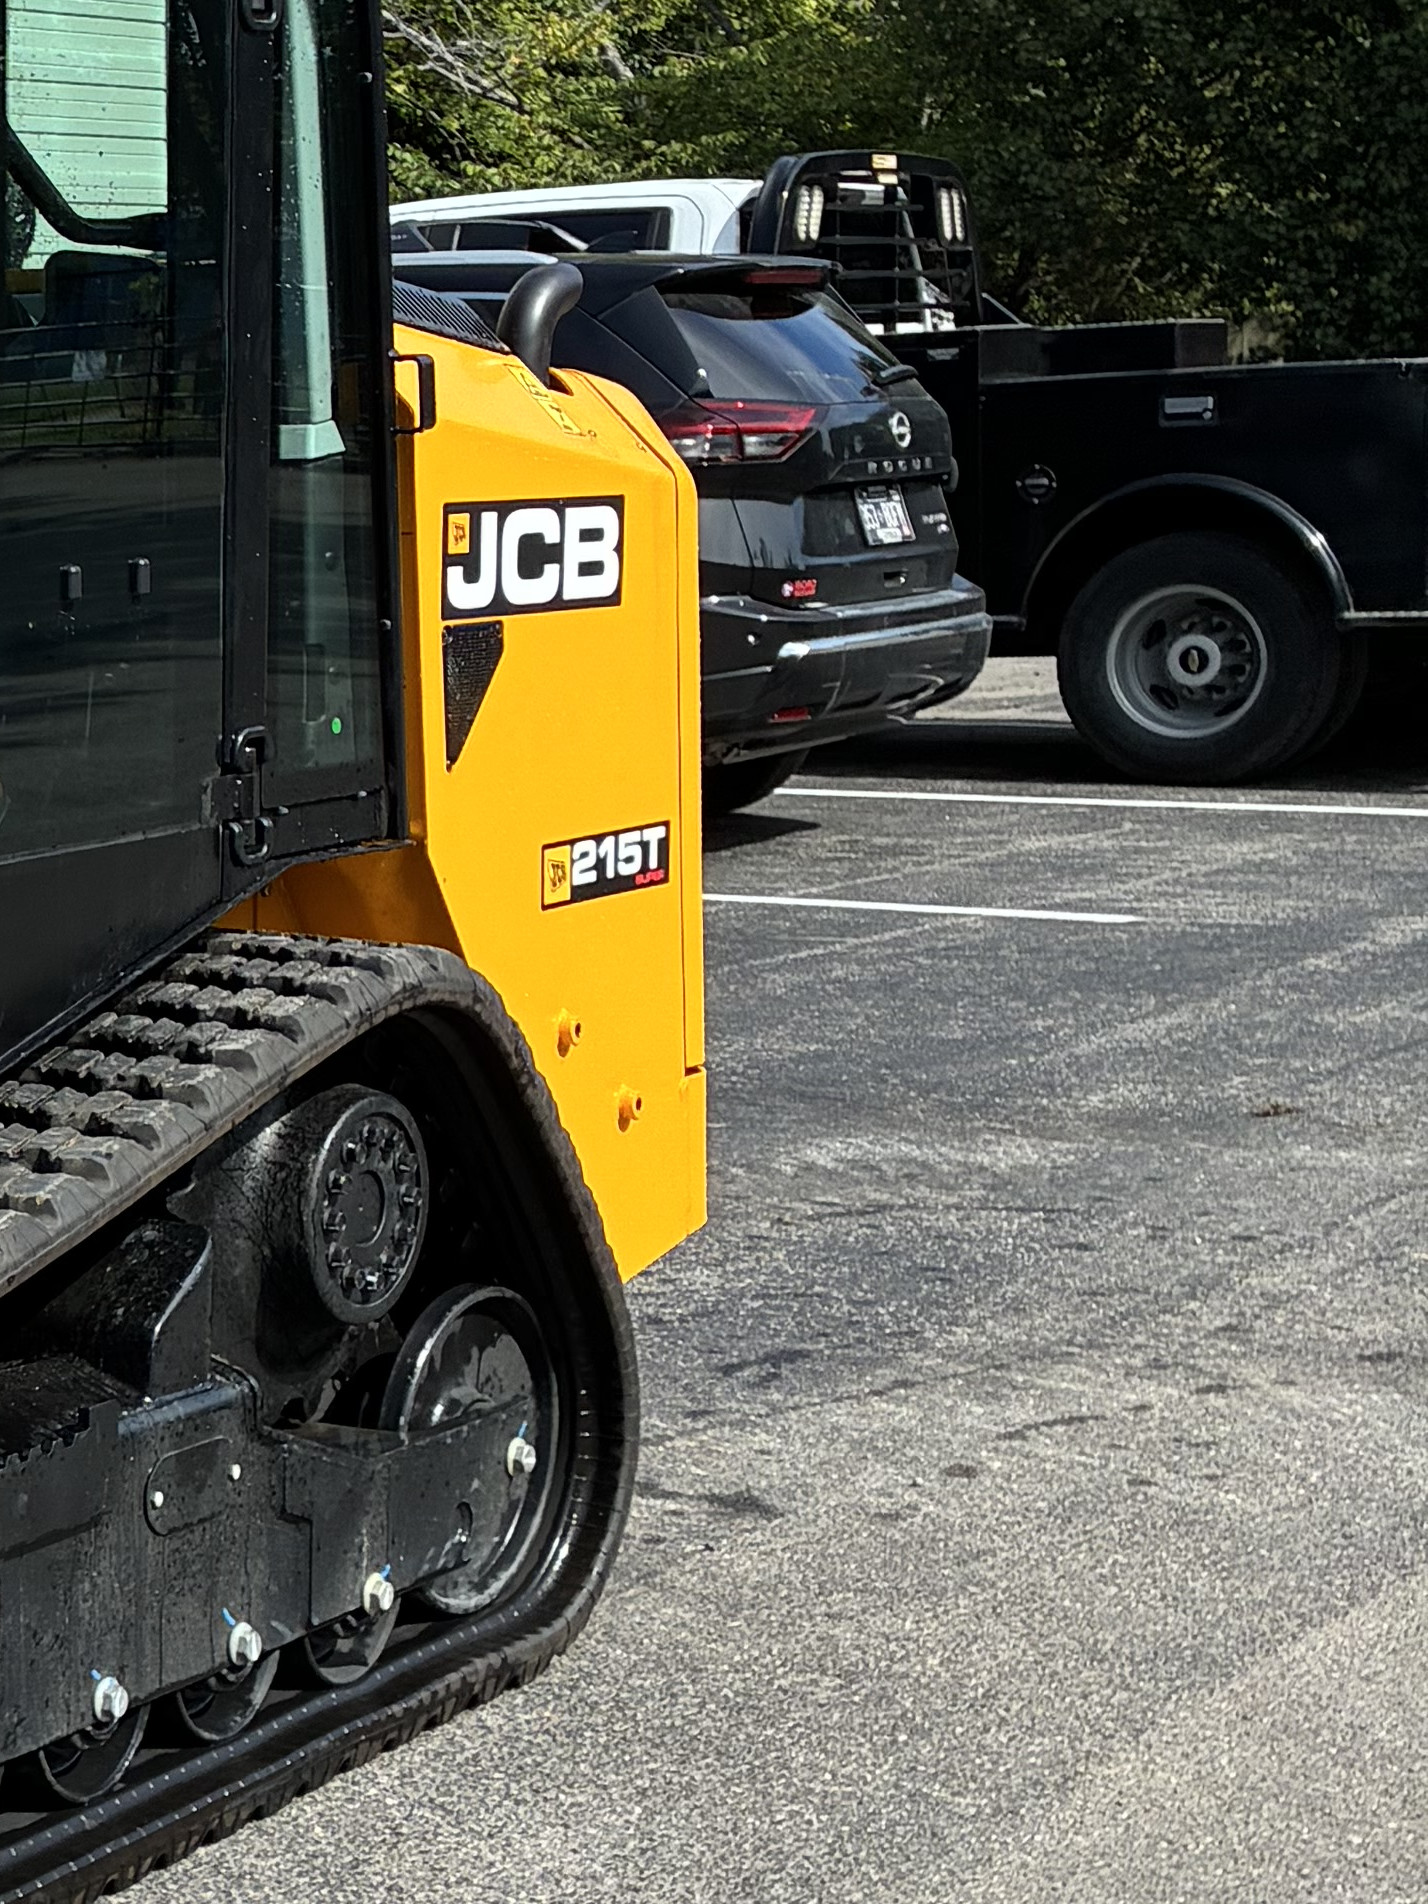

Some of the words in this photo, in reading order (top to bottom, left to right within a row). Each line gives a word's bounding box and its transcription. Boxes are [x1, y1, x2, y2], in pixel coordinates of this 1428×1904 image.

[867, 457, 933, 474] ROGUE
[447, 505, 620, 610] JCB
[572, 825, 667, 886] 215T
